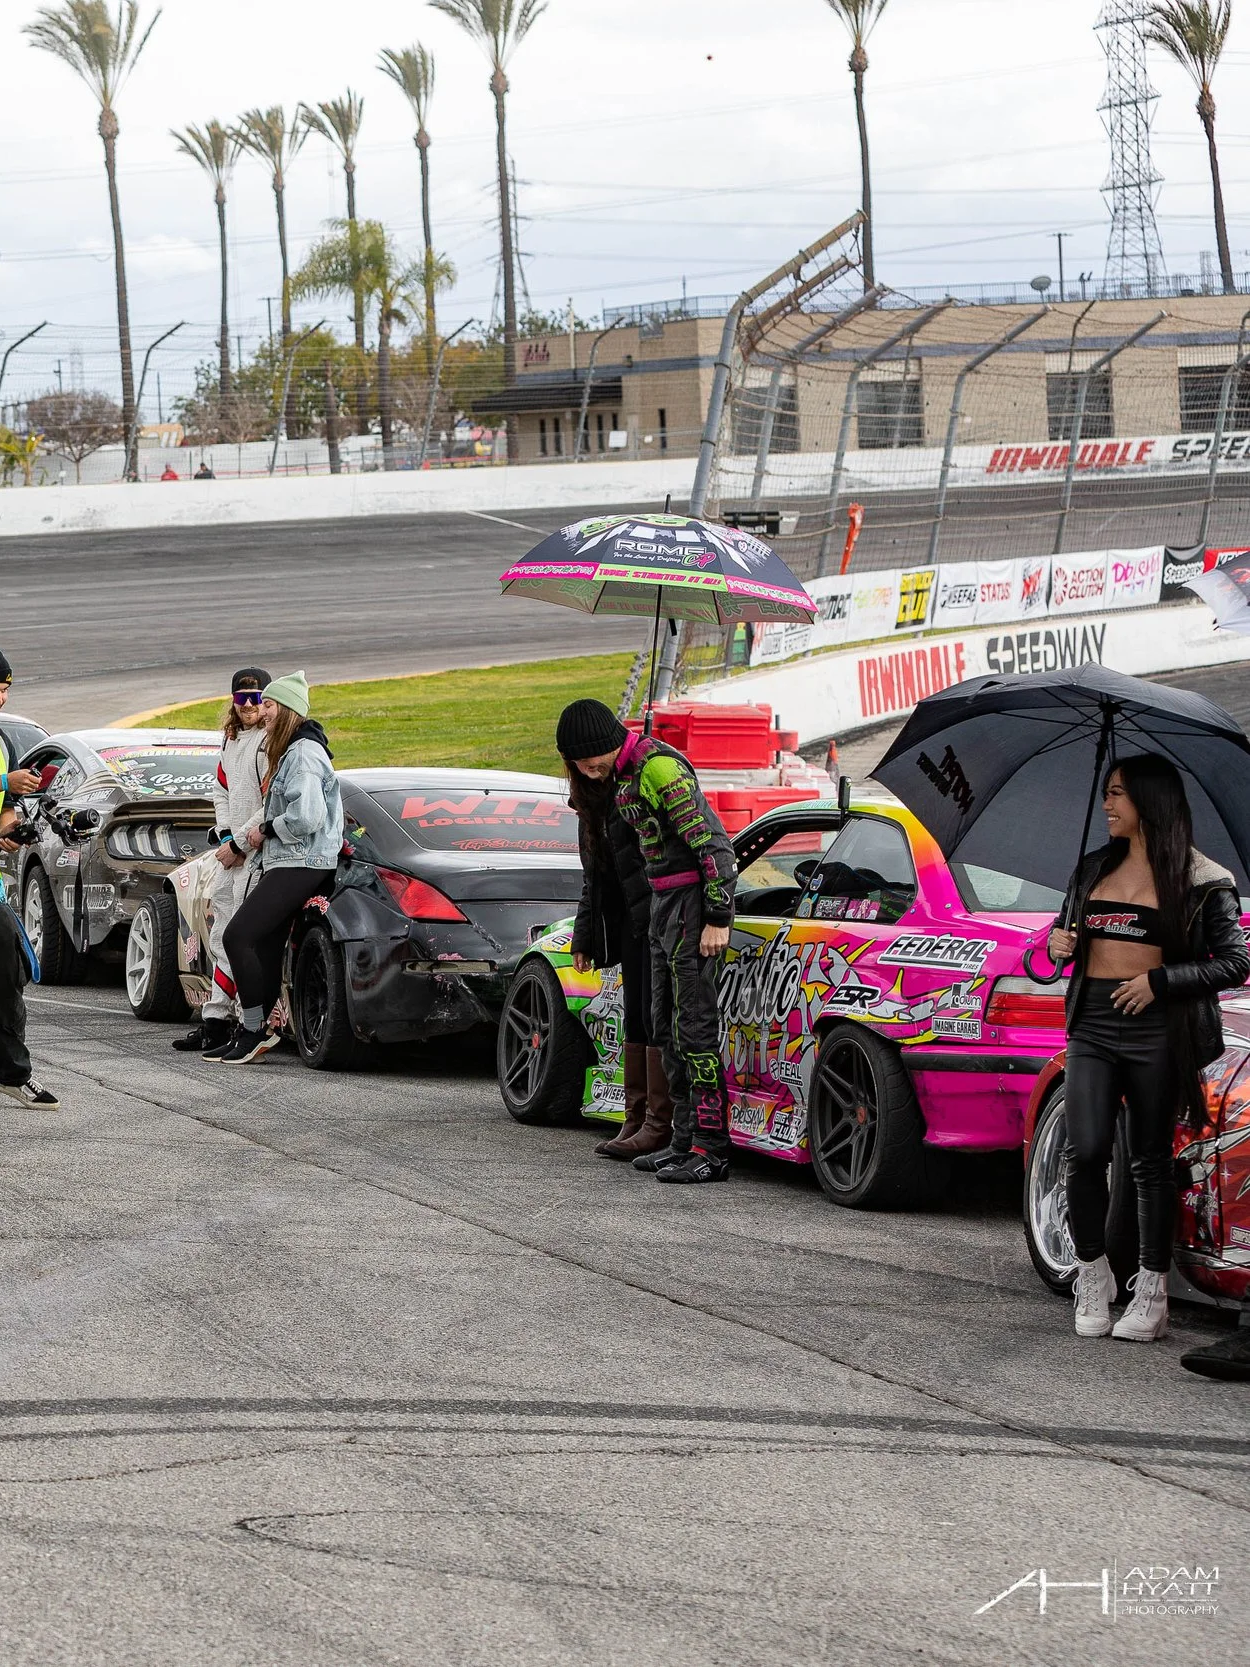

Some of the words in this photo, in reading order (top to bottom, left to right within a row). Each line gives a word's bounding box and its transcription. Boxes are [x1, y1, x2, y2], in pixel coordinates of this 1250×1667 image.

[615, 540, 707, 556] ROME
[1071, 567, 1105, 583] ACTION
[980, 583, 1012, 603] STATUS
[1068, 584, 1105, 599] CLUTCH
[857, 643, 966, 717] IRWINDALE
[986, 622, 1107, 675] SPEEDWAY
[418, 817, 561, 828] LOGISTICS
[886, 935, 989, 962] FEDERAL
[934, 1019, 956, 1033] IMAGINE
[956, 1020, 979, 1035] GARAGE
[780, 1060, 802, 1079] FEAL
[771, 1124, 798, 1141] CLUB
